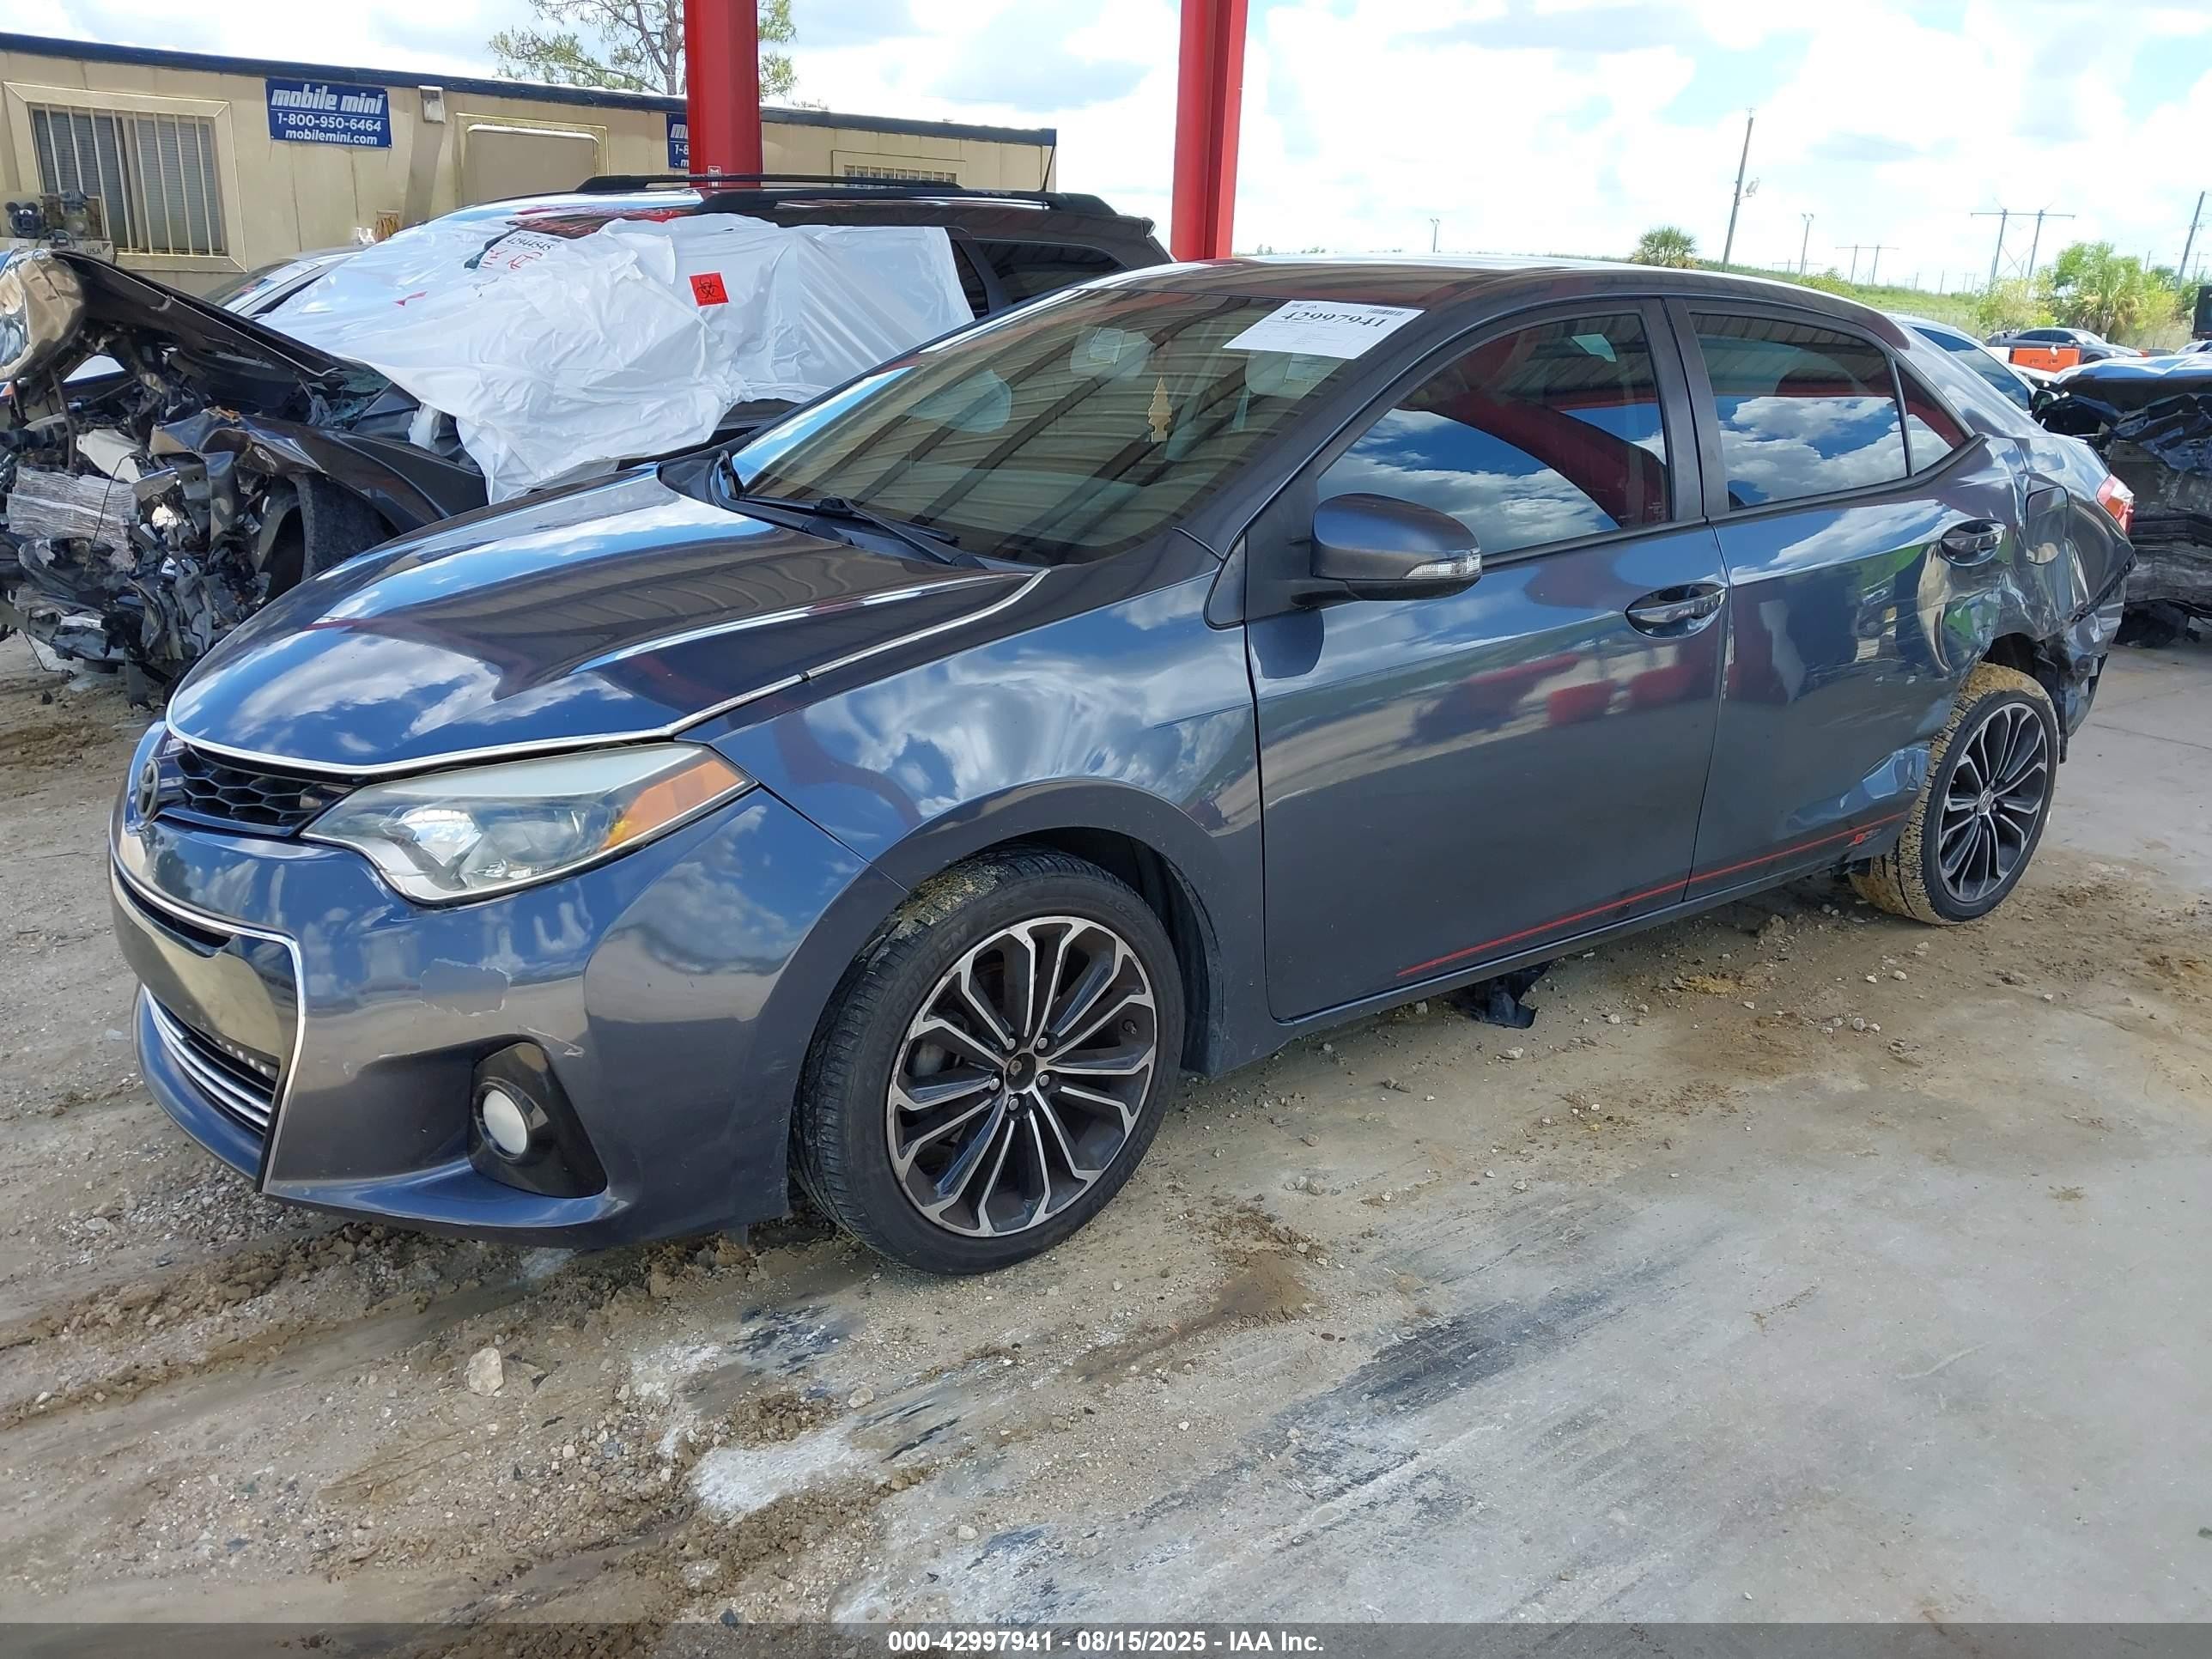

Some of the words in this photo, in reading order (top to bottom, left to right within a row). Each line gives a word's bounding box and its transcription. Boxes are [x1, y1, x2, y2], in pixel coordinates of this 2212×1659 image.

[270, 83, 337, 111] mobile
[340, 92, 384, 114] mini
[276, 112, 381, 132] 1-800-950-6464
[285, 129, 378, 145] mobilemini.com
[1280, 311, 1389, 328] 42997941
